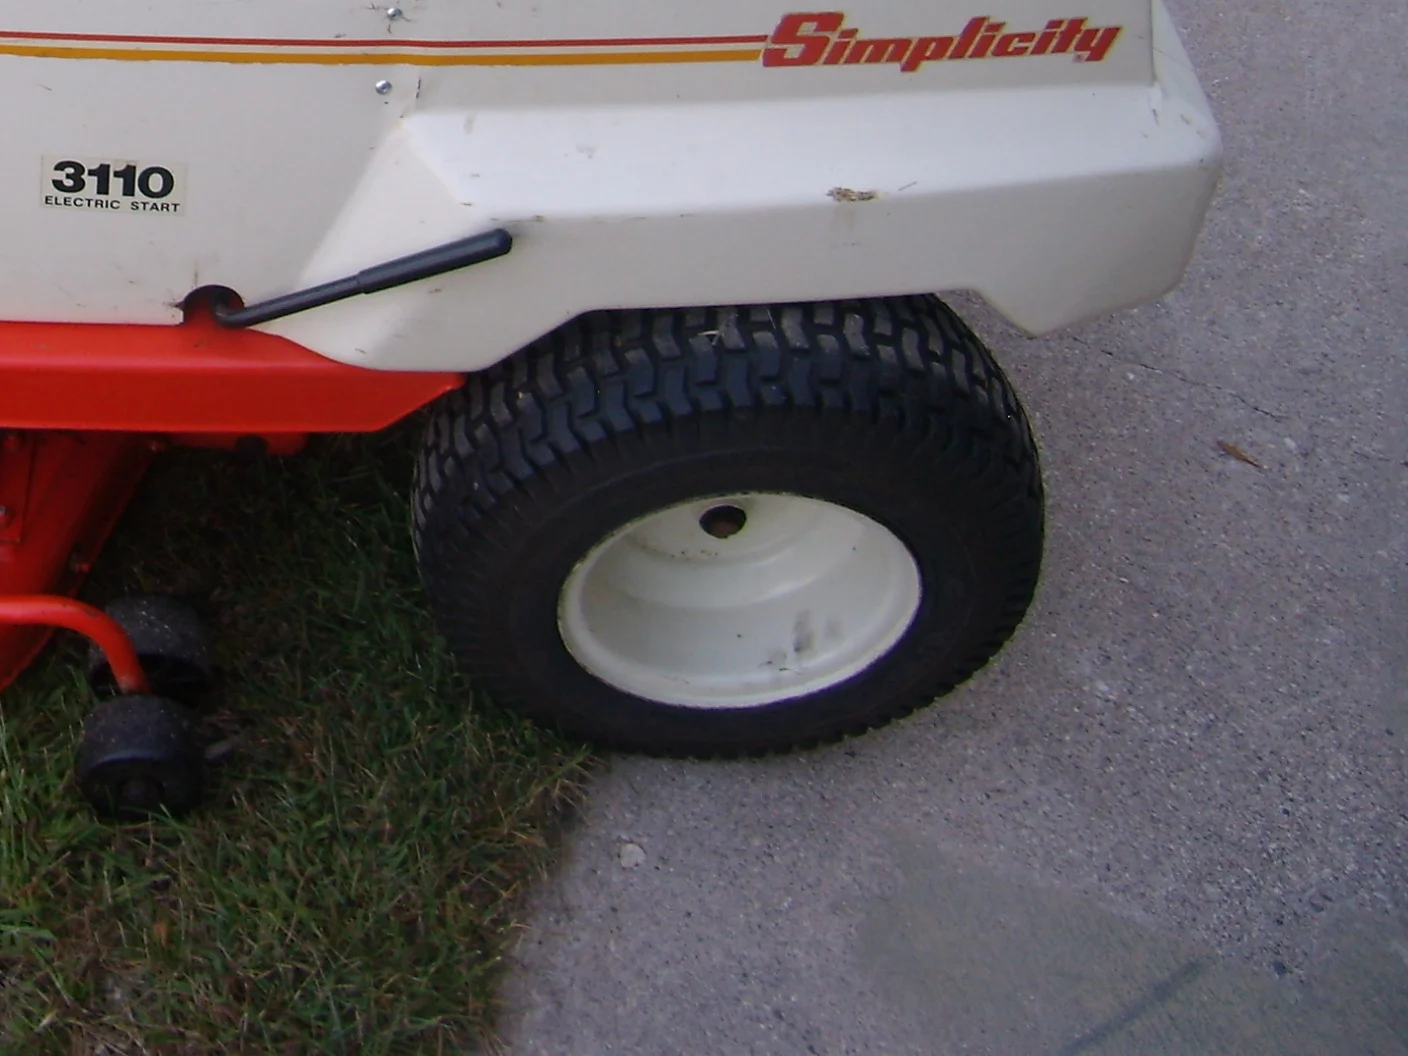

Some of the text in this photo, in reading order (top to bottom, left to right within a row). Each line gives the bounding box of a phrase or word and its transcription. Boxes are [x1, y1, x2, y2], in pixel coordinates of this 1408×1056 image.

[762, 11, 1123, 73] Simplicity
[52, 160, 174, 199] 3110
[45, 195, 180, 213] ELECTRIC START
